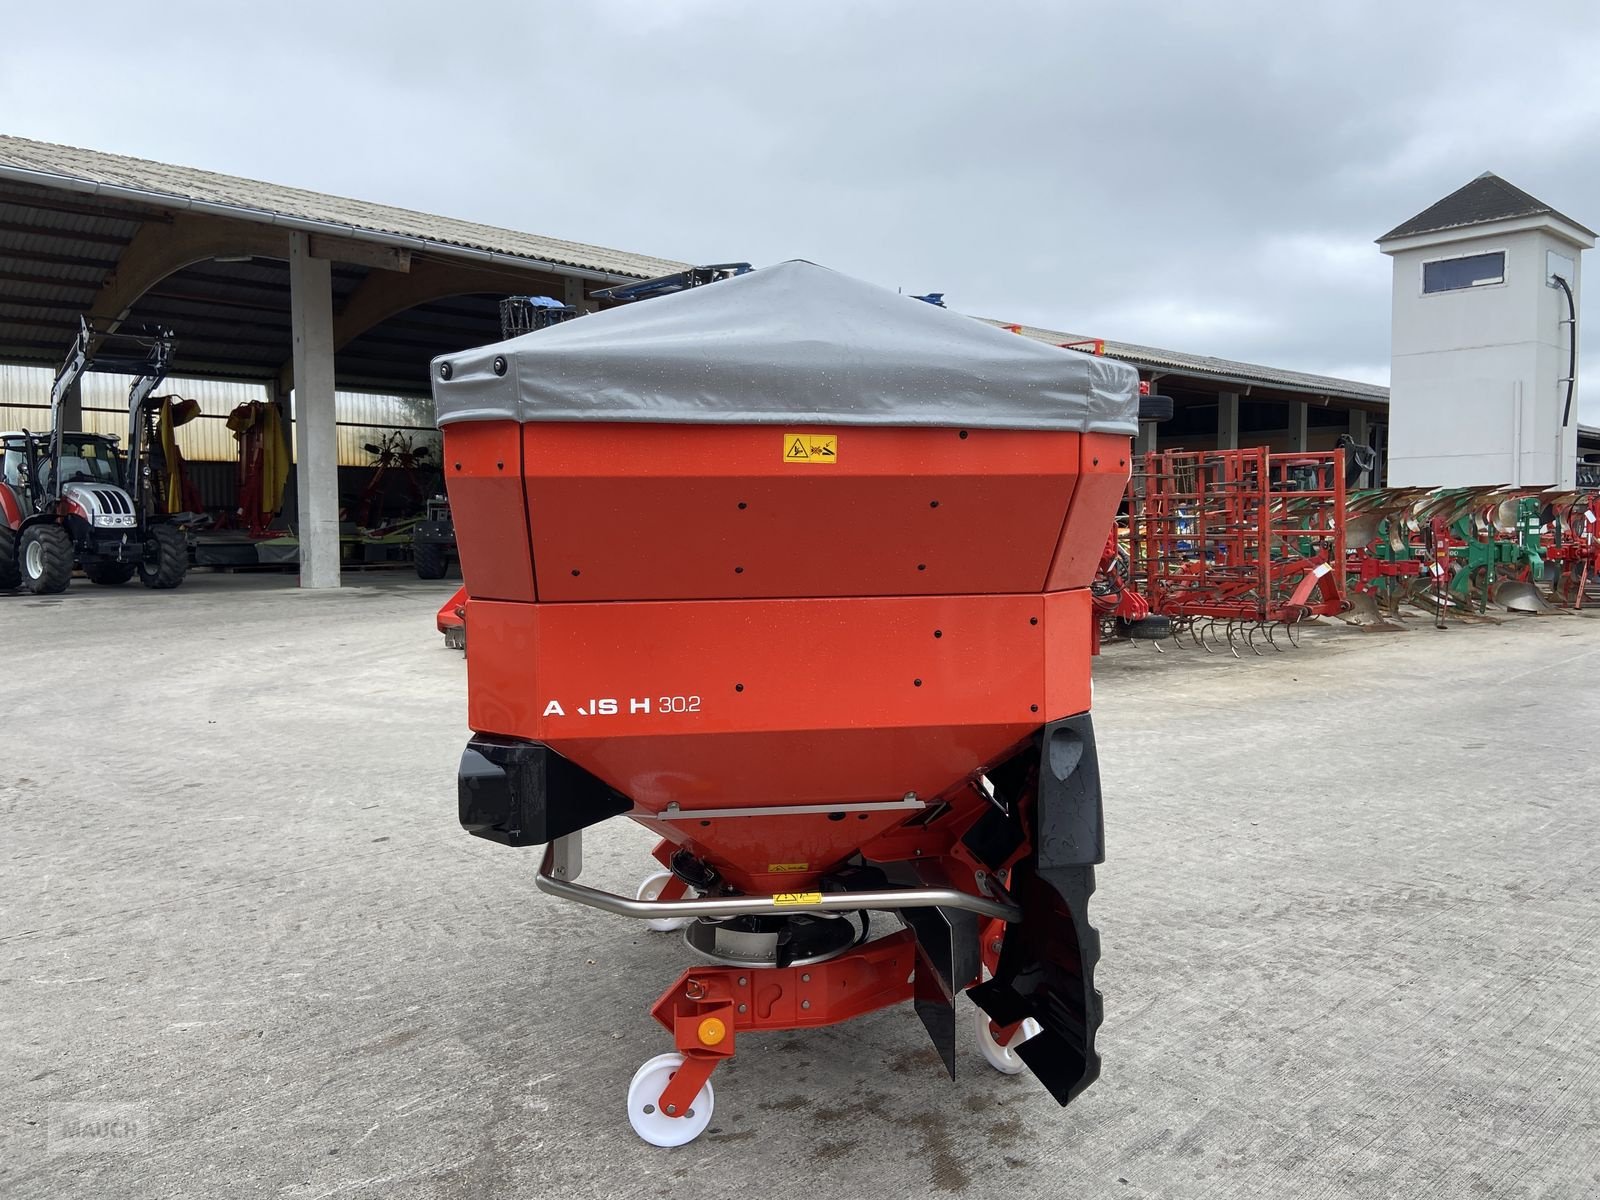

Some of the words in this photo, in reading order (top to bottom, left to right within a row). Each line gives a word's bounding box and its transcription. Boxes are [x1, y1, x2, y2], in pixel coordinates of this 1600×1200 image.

[543, 698, 618, 717] AIS
[630, 697, 651, 714] H
[658, 695, 701, 713] 30.2
